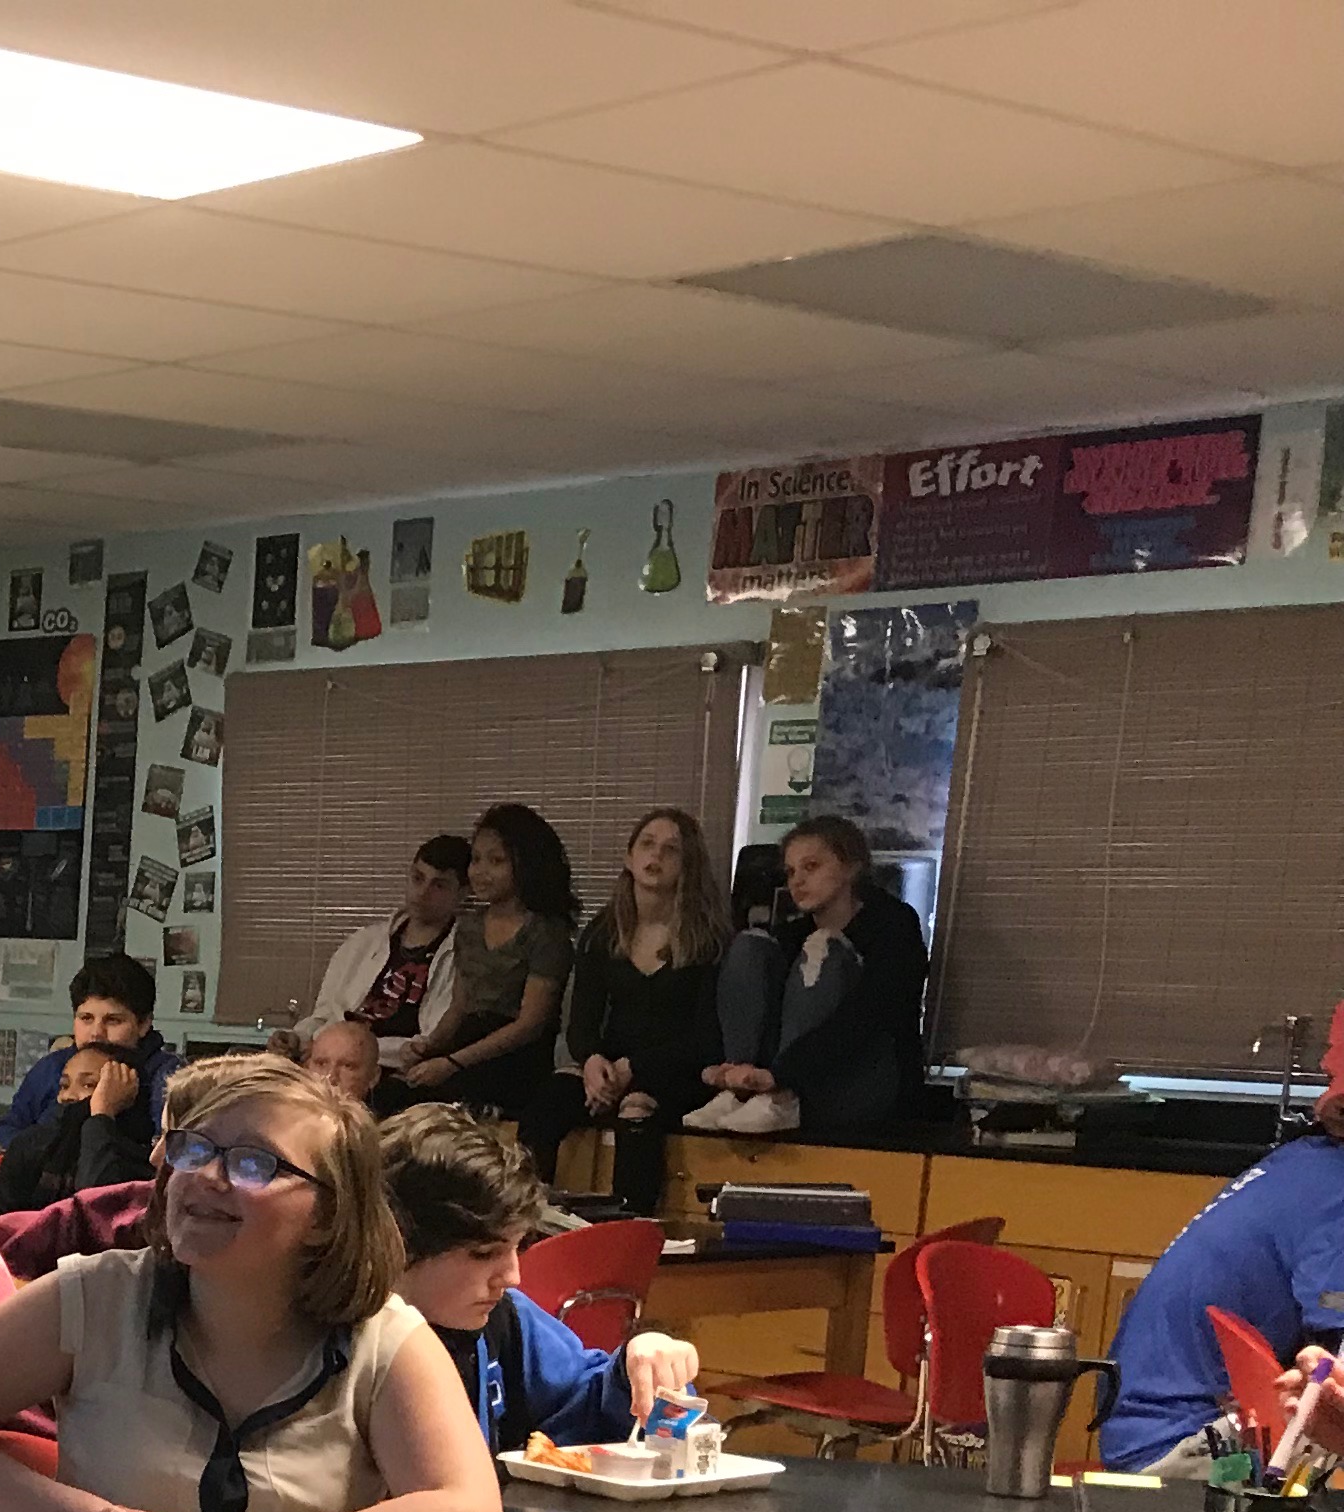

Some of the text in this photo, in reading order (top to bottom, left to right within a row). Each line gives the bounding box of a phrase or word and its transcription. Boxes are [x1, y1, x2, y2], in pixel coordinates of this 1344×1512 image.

[739, 476, 760, 500] In
[909, 450, 1043, 497] Effort
[713, 495, 875, 569] MATTER
